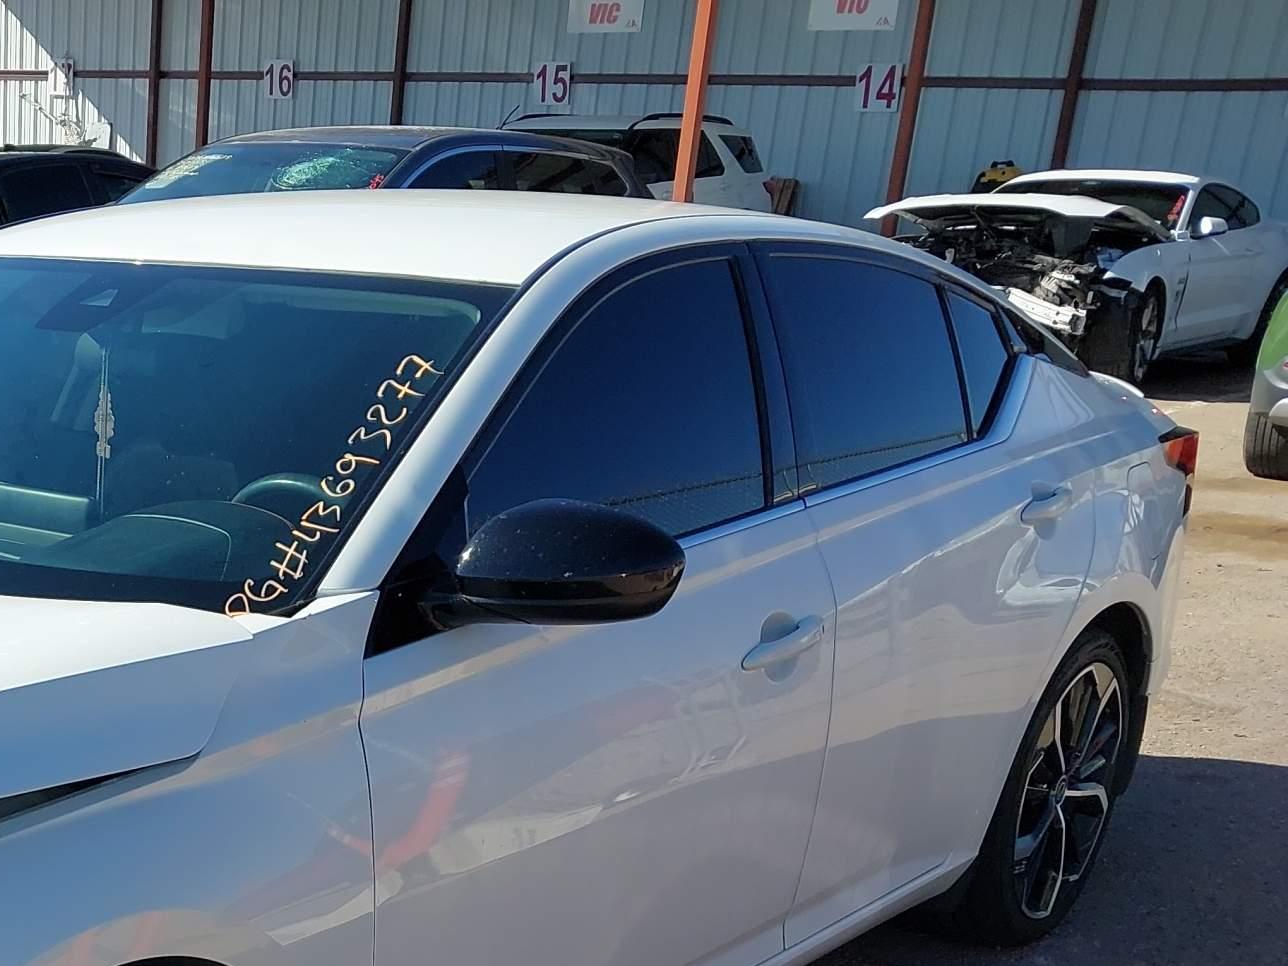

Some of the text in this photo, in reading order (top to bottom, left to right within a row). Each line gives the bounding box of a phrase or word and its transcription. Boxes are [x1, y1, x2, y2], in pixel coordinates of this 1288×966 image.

[588, 2, 621, 25] VIC
[265, 63, 292, 97] 16
[536, 64, 568, 104] 15
[858, 64, 897, 109] 14
